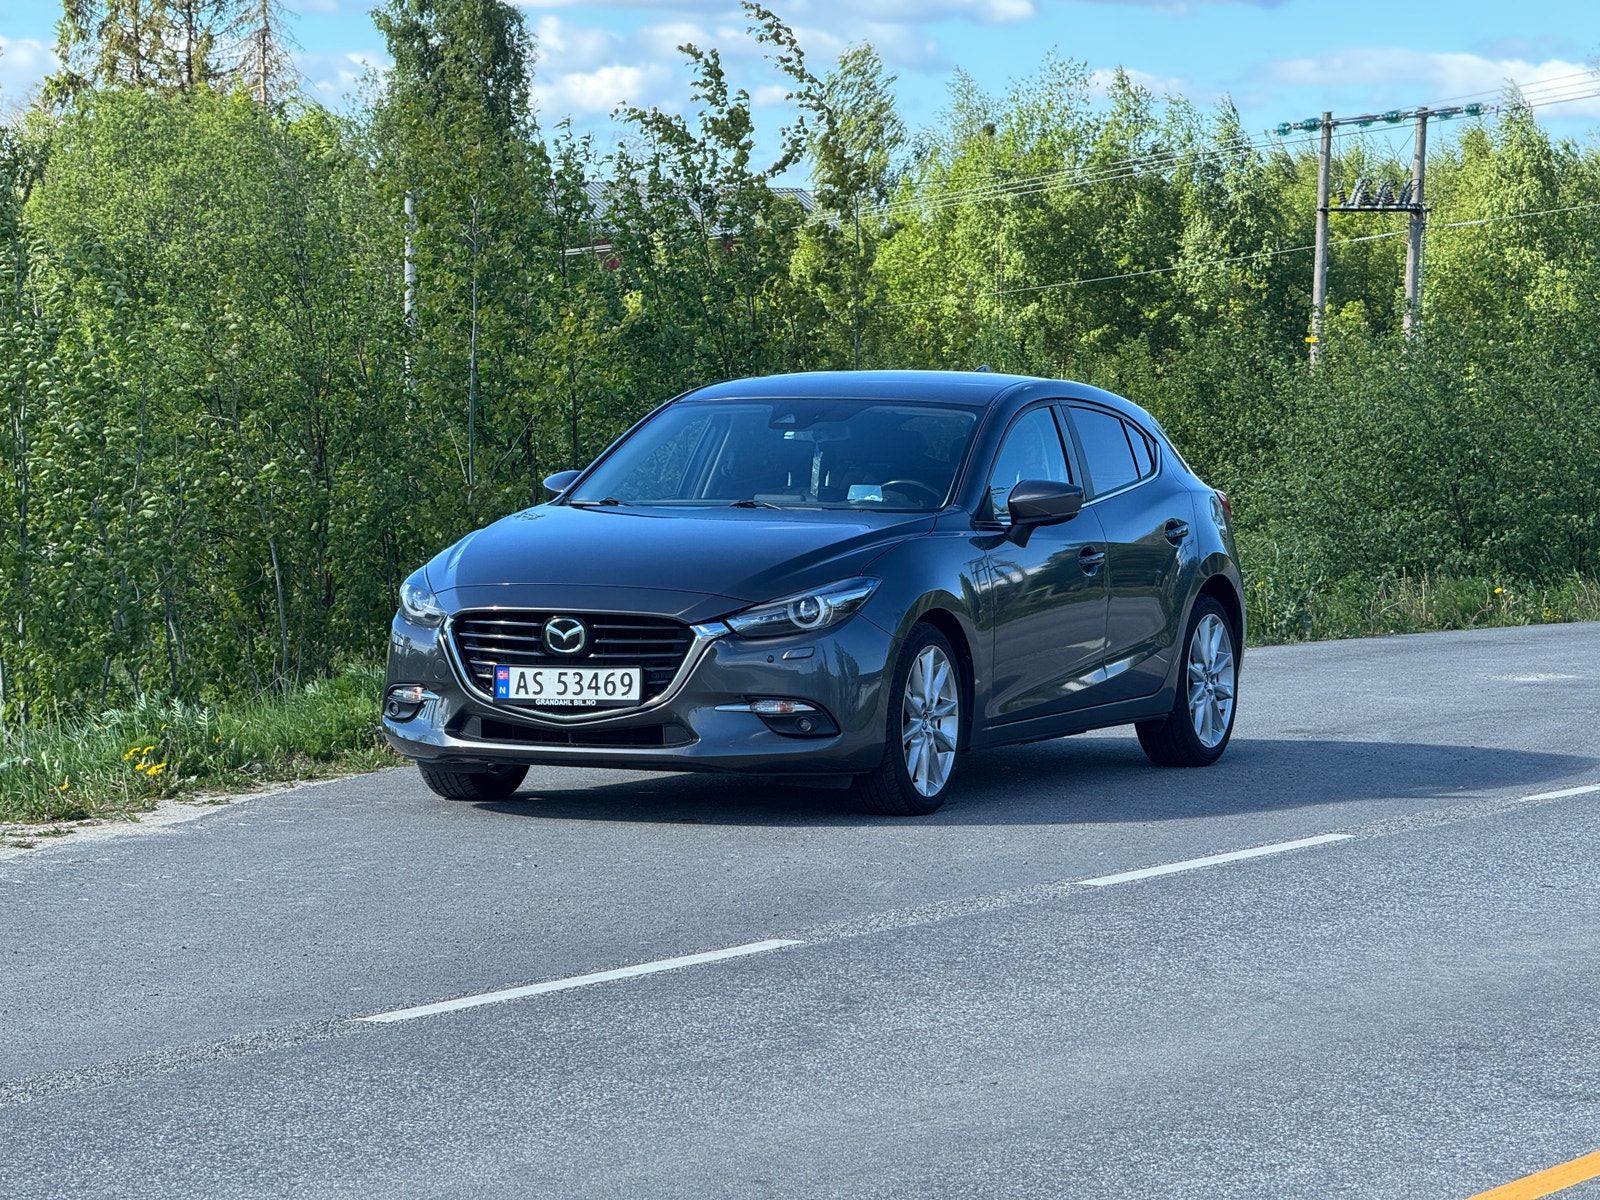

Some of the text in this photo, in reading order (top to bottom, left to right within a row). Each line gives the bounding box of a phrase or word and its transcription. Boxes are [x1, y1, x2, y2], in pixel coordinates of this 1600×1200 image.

[499, 686, 506, 694] N
[515, 671, 633, 697] AS 53469
